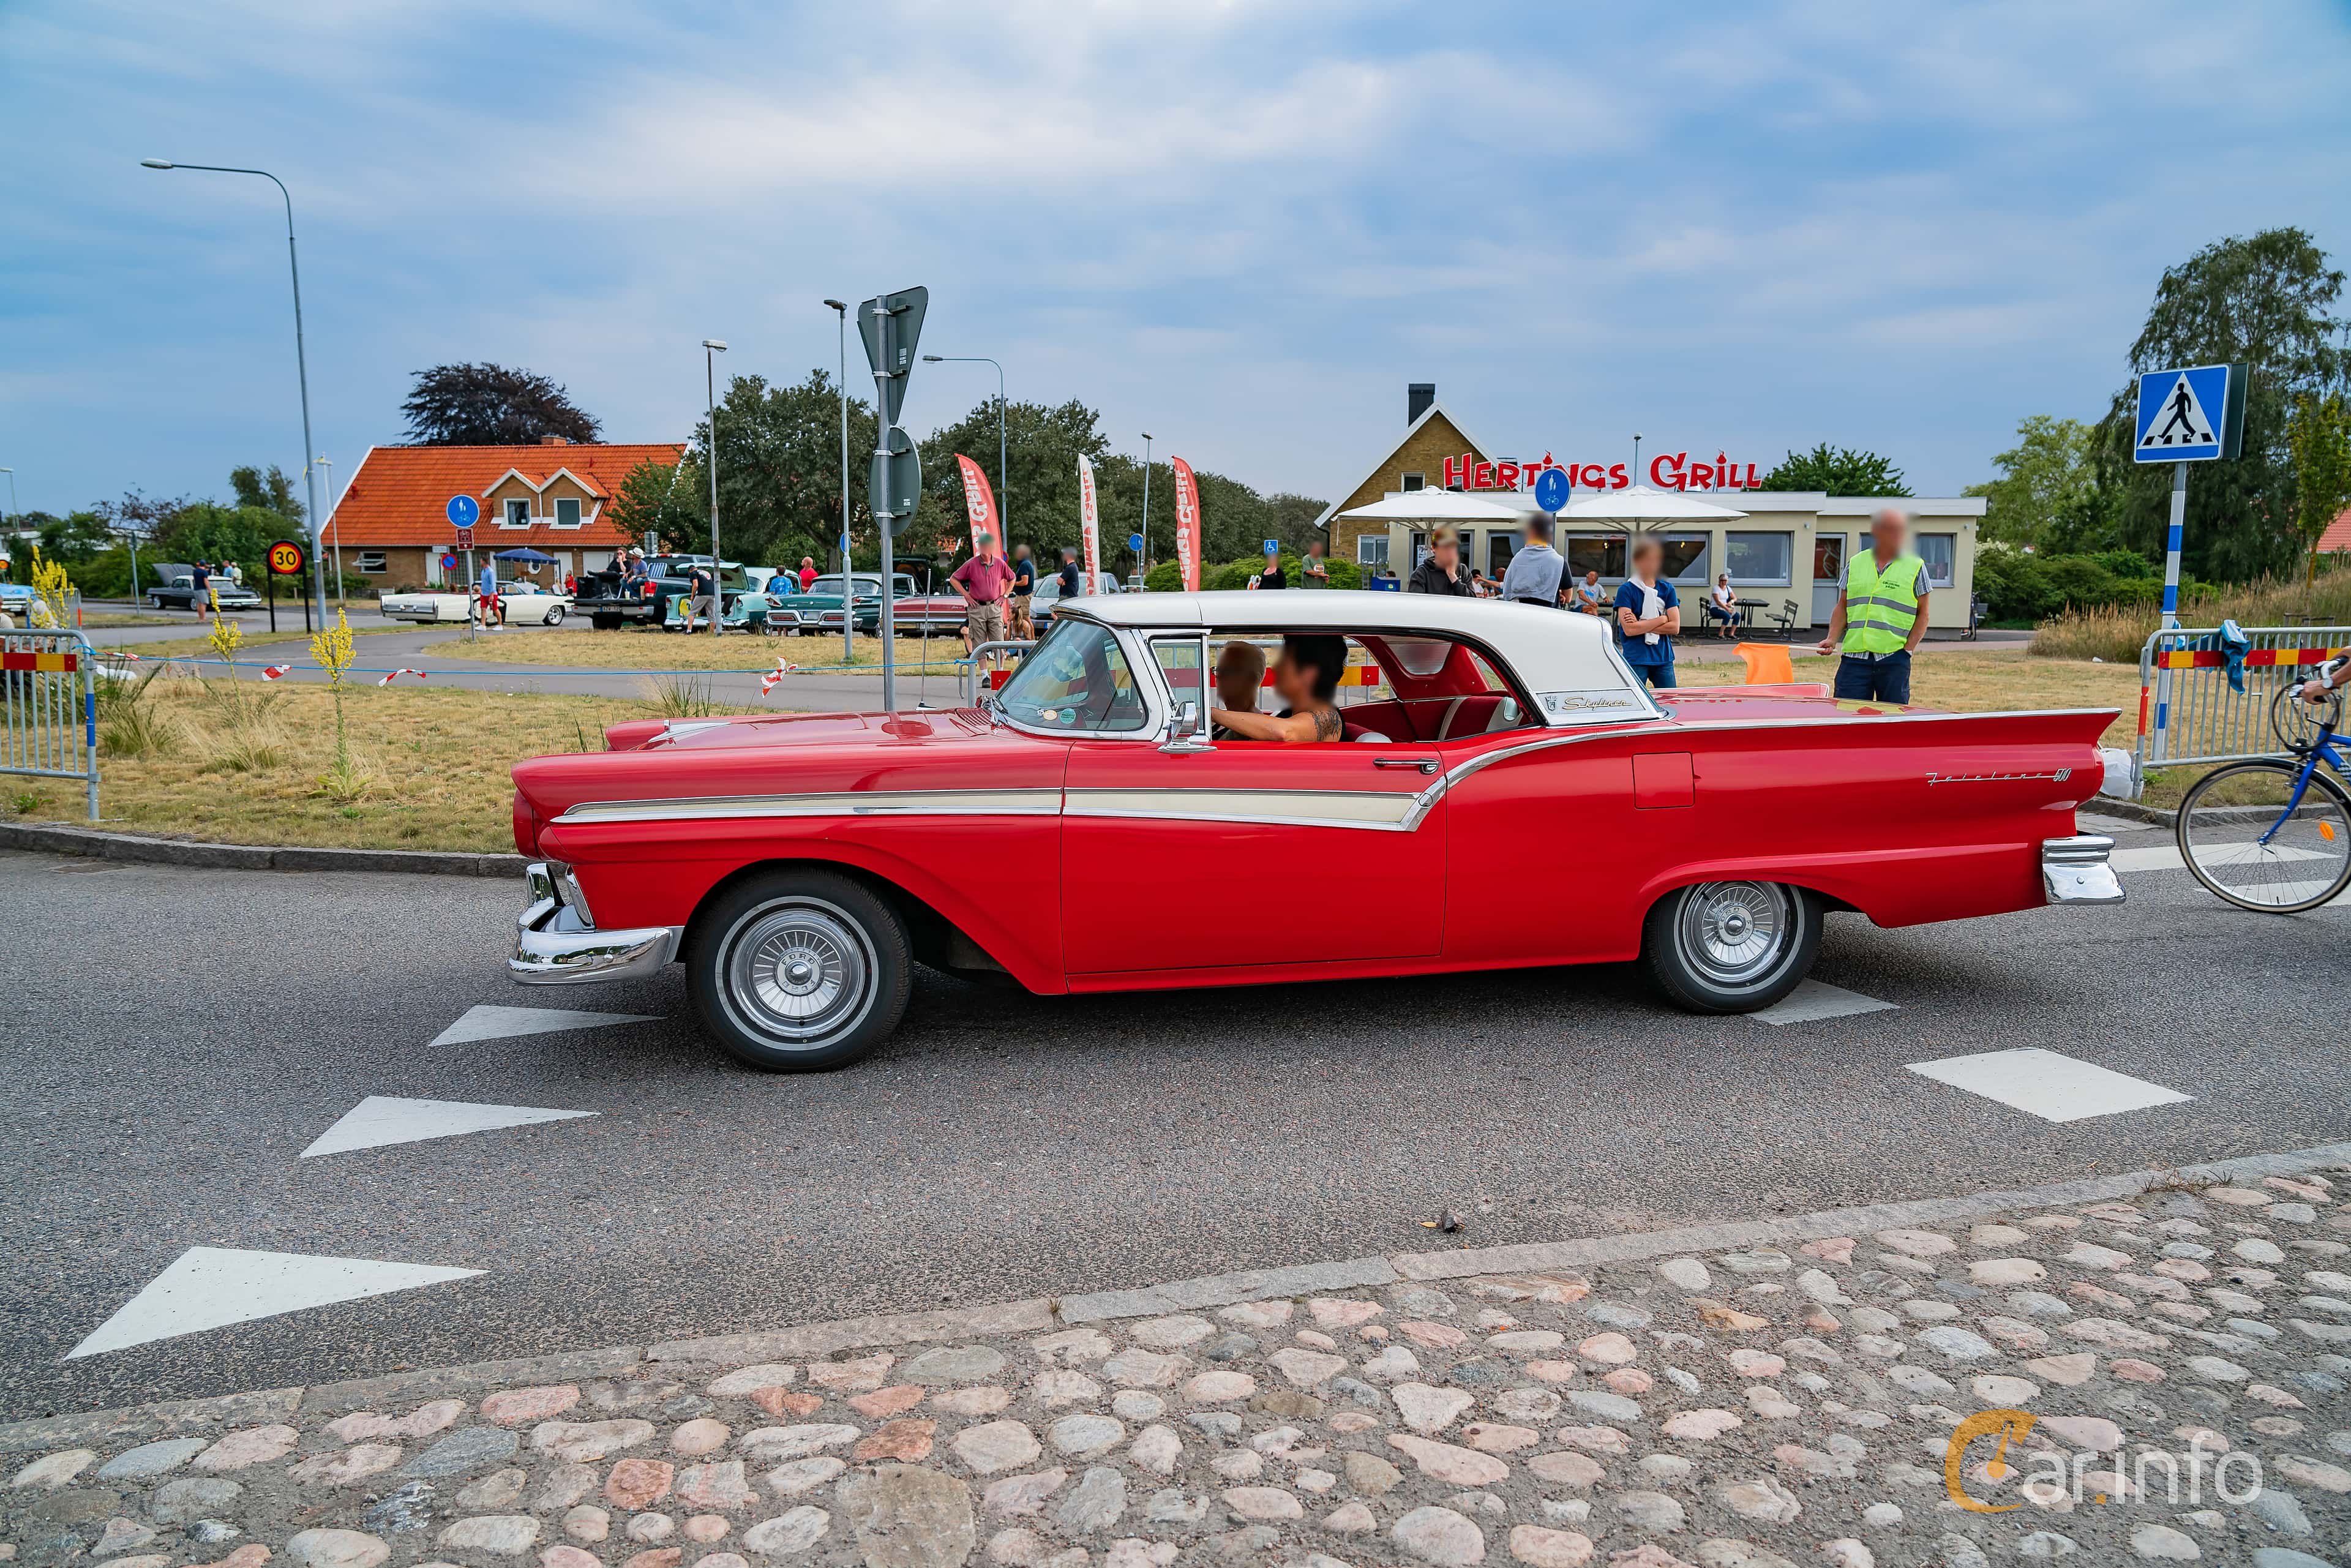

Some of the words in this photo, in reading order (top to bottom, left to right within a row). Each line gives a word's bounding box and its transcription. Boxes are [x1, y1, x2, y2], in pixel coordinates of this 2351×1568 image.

[1650, 450, 1761, 492] GRILL
[276, 551, 296, 565] 30
[1562, 696, 1632, 711] Skyliner
[1925, 771, 2043, 787] Fairlane
[2052, 768, 2072, 781] 500
[781, 953, 815, 966] FORD
